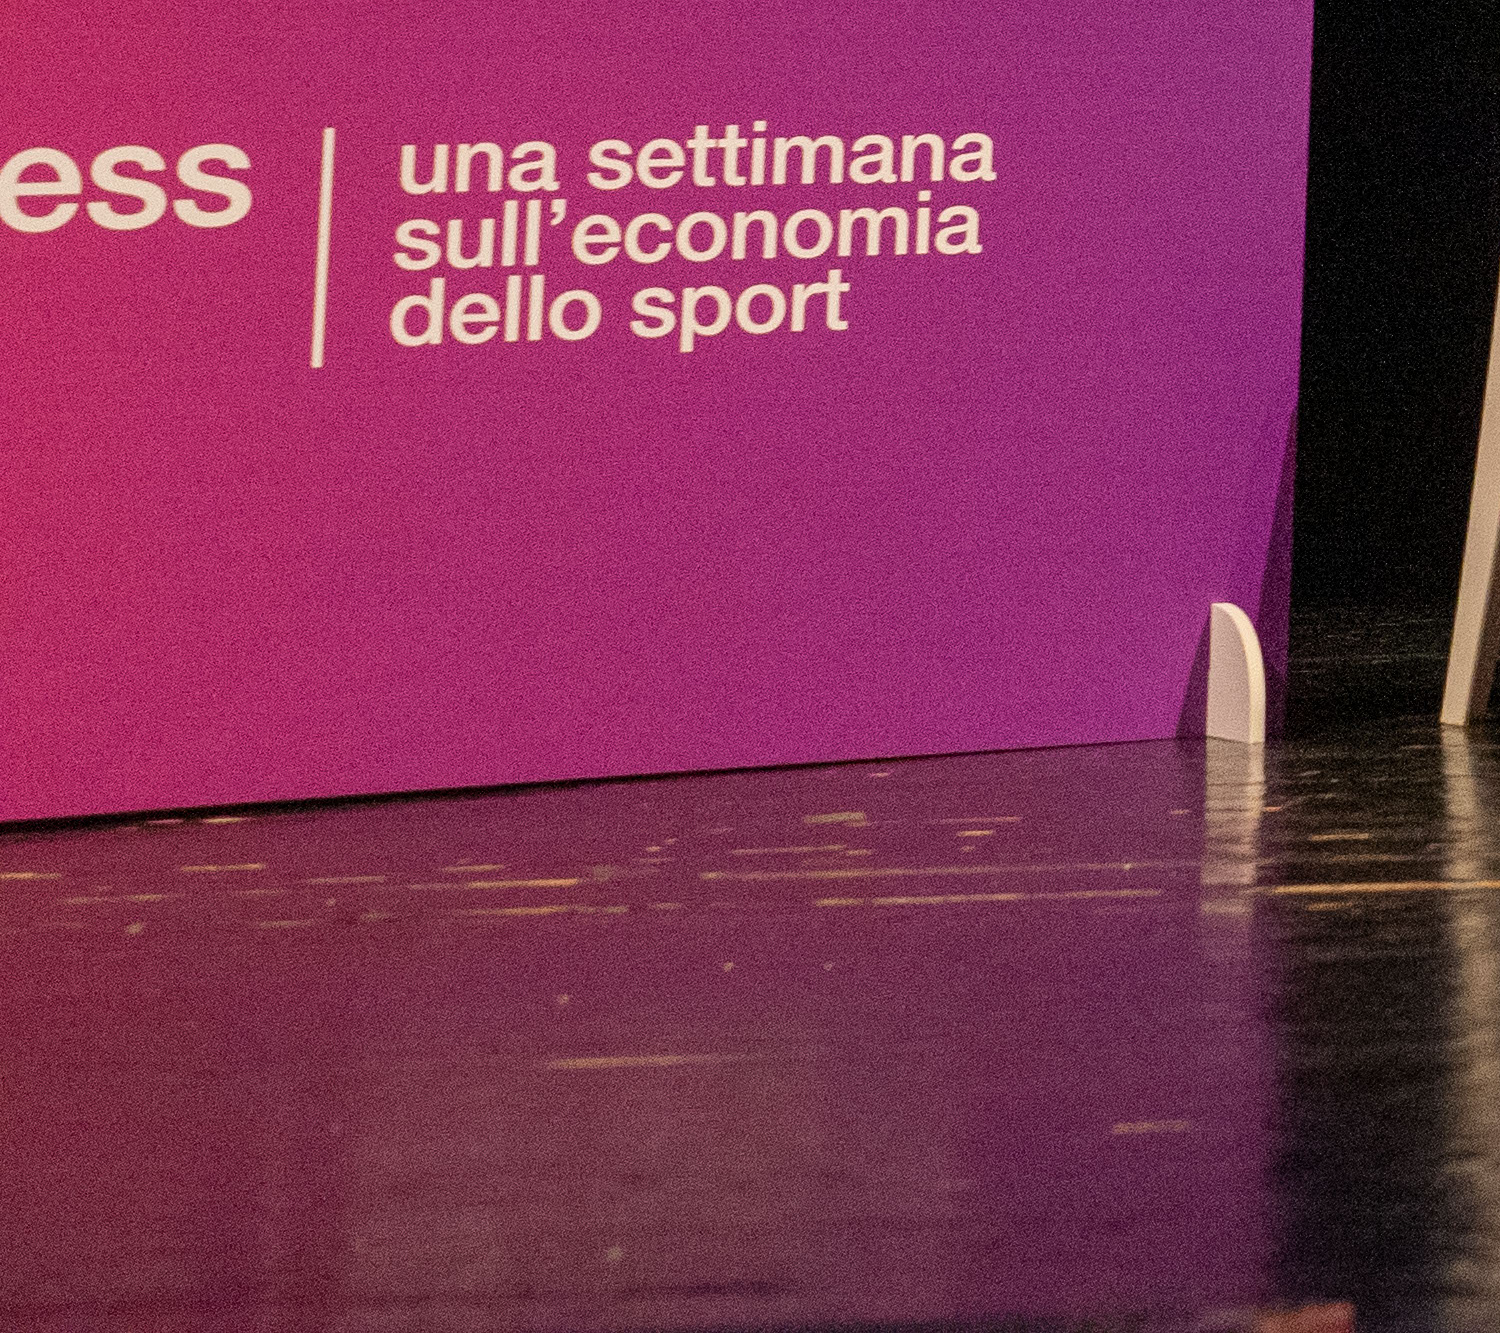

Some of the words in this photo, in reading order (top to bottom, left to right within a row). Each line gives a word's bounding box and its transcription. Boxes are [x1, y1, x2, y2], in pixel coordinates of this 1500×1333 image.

[400, 139, 560, 196] una
[587, 120, 998, 190] settimana
[393, 190, 983, 271] sull'economia
[389, 274, 602, 347] dello
[630, 266, 851, 352] sport
